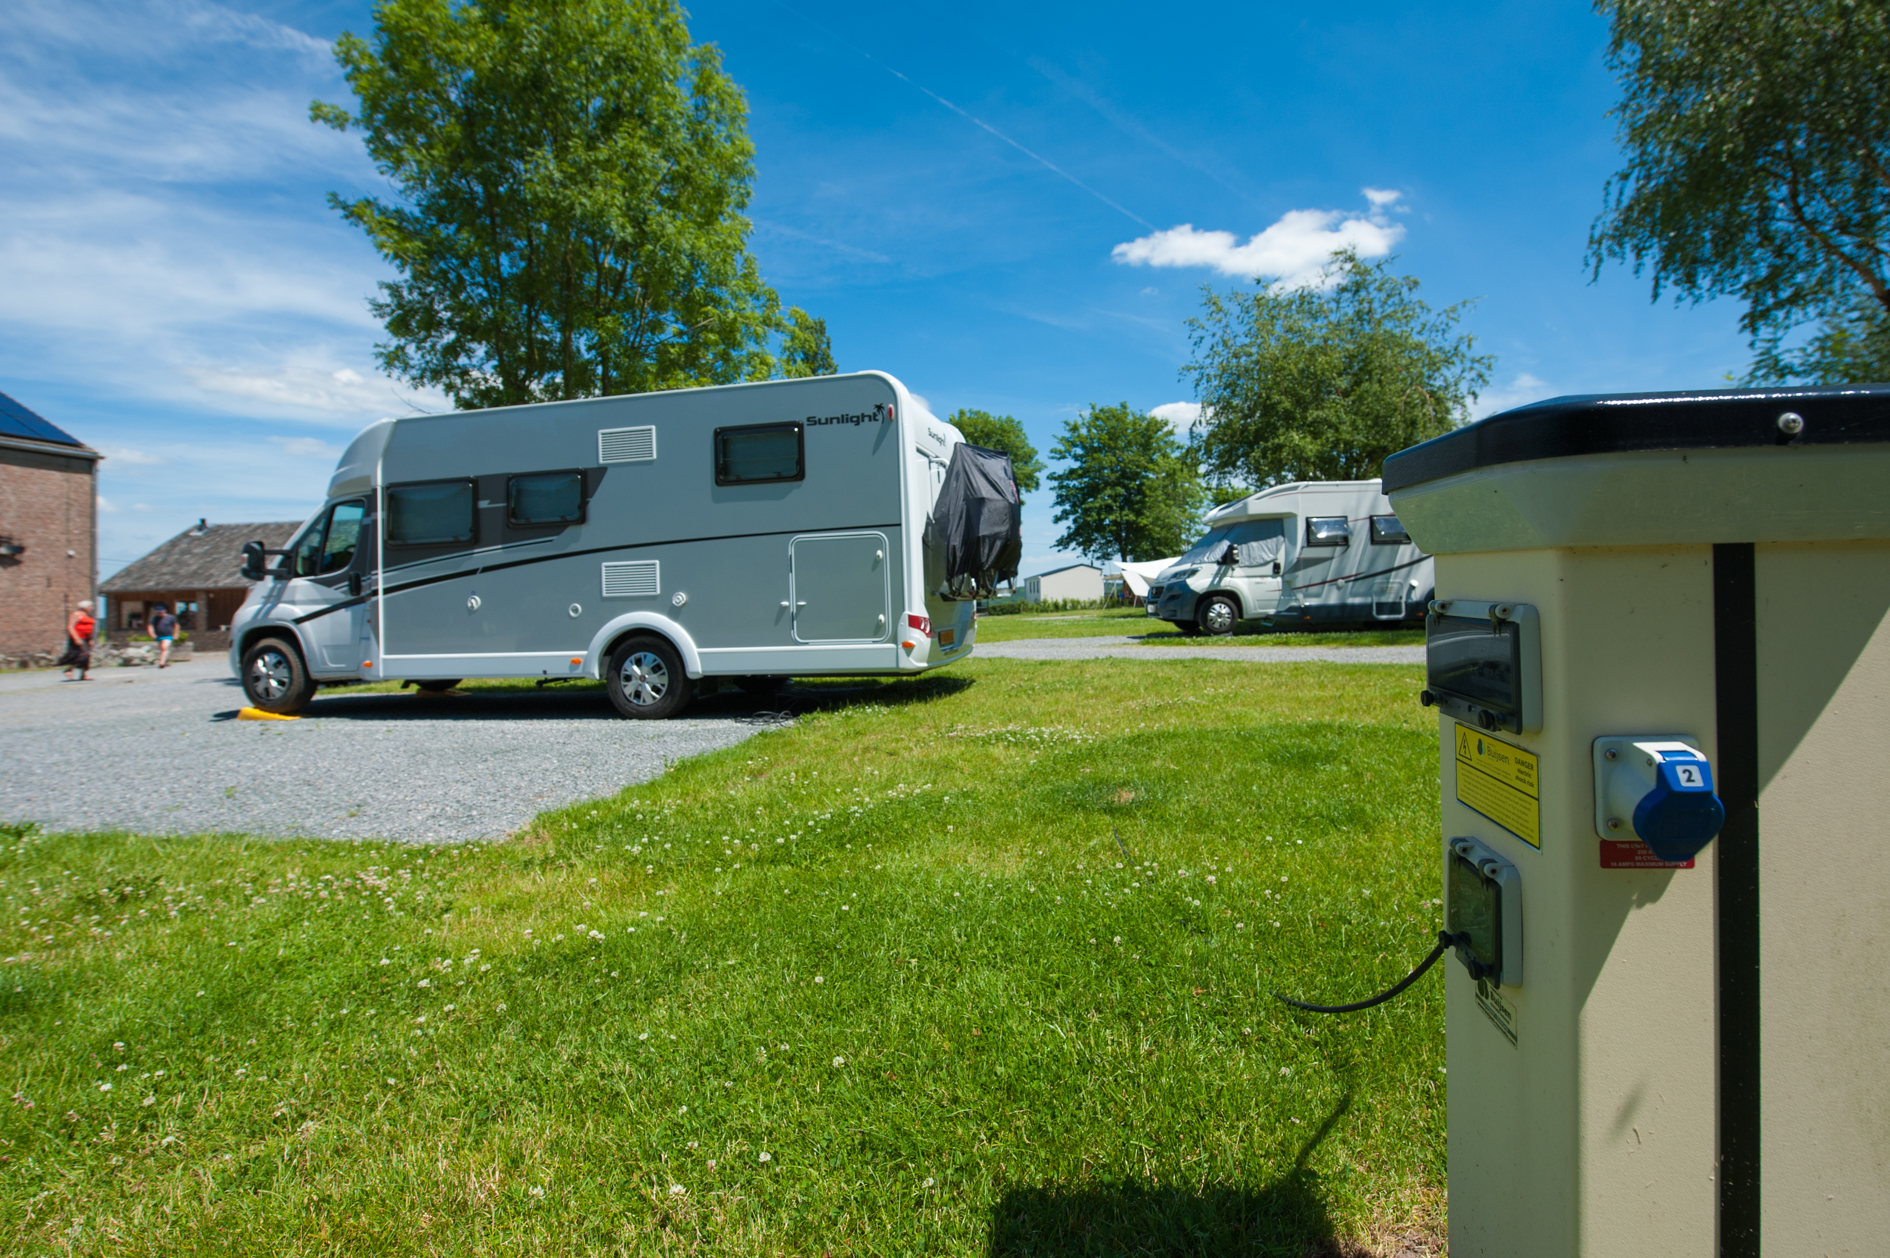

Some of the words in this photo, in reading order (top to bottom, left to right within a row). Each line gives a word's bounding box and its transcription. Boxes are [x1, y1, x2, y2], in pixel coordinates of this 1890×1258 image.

[806, 411, 879, 426] Sunlight
[1486, 745, 1510, 765] Buijsen
[1514, 757, 1534, 771] DANGER
[1517, 768, 1532, 779] electric
[1682, 769, 1696, 783] 2
[1515, 775, 1526, 785] shock
[1527, 780, 1535, 788] risk
